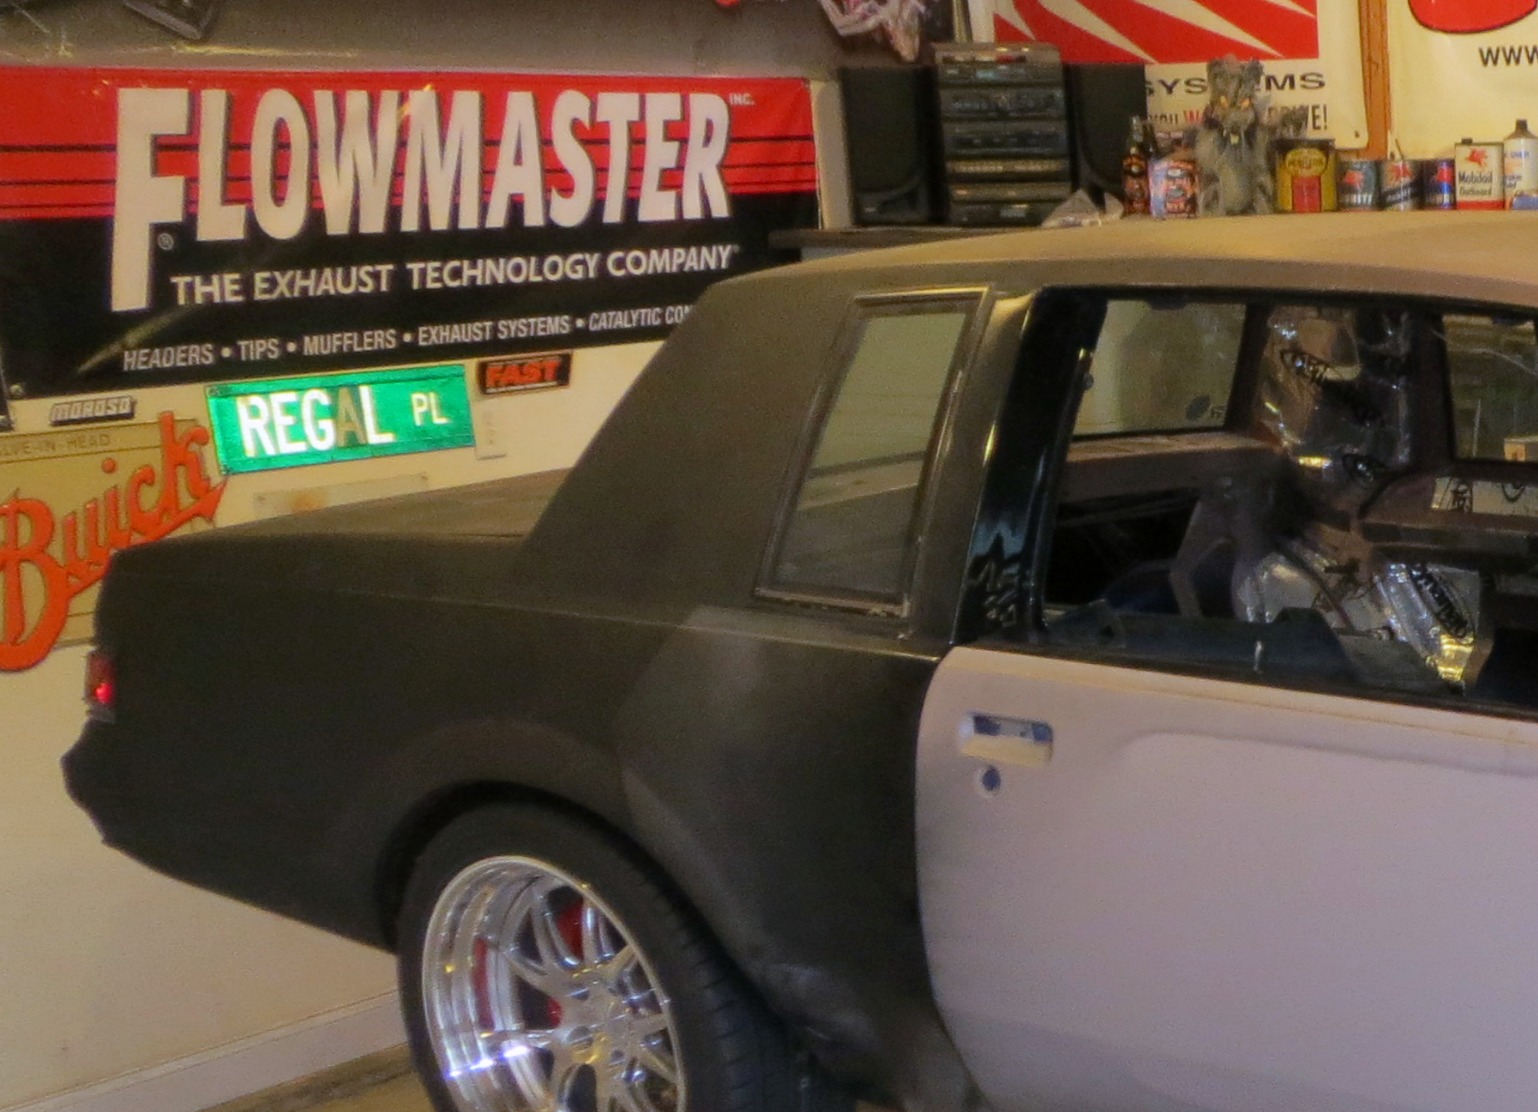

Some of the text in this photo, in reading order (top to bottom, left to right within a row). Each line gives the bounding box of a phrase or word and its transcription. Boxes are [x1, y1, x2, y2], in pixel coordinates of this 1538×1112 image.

[1145, 72, 1326, 96] YSMS
[111, 86, 732, 312] FLOWMASTER
[170, 244, 734, 305] THE EXHAUST TECHNOLOGY COMPANY
[123, 344, 215, 371] HEADERS
[237, 338, 280, 362] TIPS
[303, 328, 397, 356] MUFFLERS
[418, 321, 492, 346] EXHAUST
[497, 314, 571, 340] SYSTEMS
[588, 306, 663, 332] CATALYTIC
[485, 358, 562, 388] FAST
[51, 396, 132, 424] MOROSO
[235, 383, 450, 458] REGAL PL
